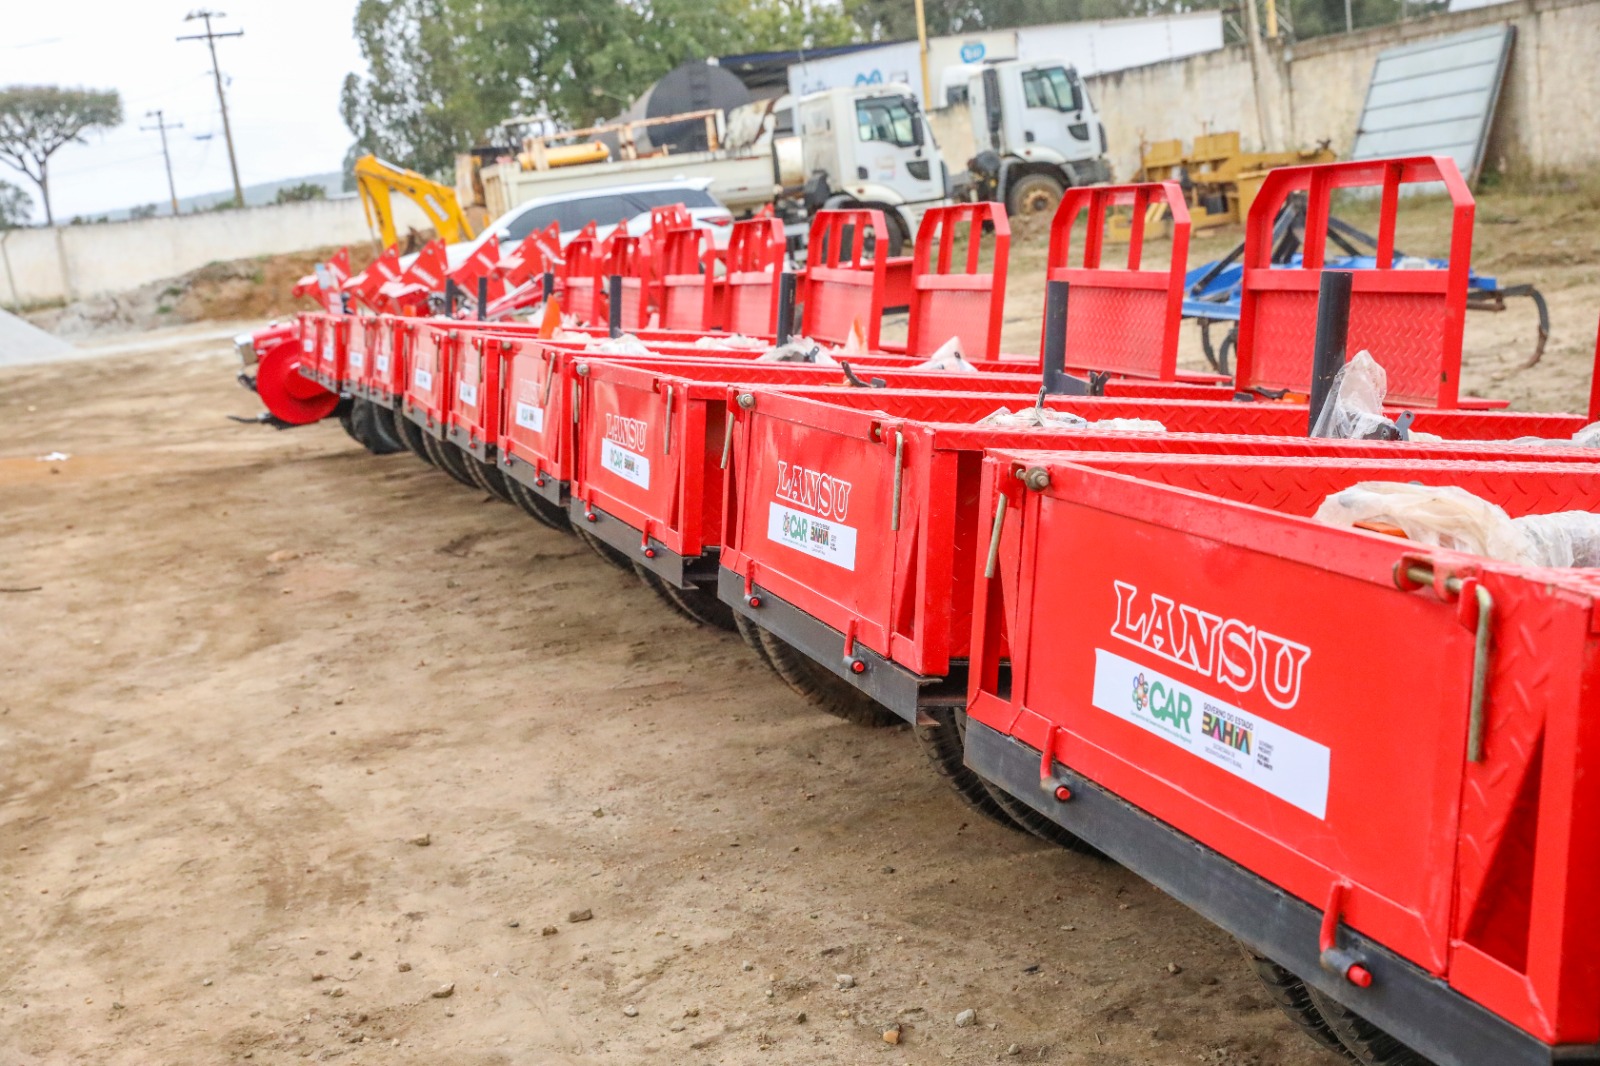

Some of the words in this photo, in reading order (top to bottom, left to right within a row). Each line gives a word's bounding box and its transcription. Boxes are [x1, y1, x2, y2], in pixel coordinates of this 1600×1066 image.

[605, 413, 647, 452] LANSU
[776, 460, 852, 523] LANSU
[790, 515, 808, 543] CAR
[1110, 579, 1311, 709] LANSU
[1149, 681, 1192, 734] CAR
[1204, 702, 1226, 719] GOVERNO
[1227, 712, 1234, 723] DO
[1235, 716, 1254, 731] ESTADO
